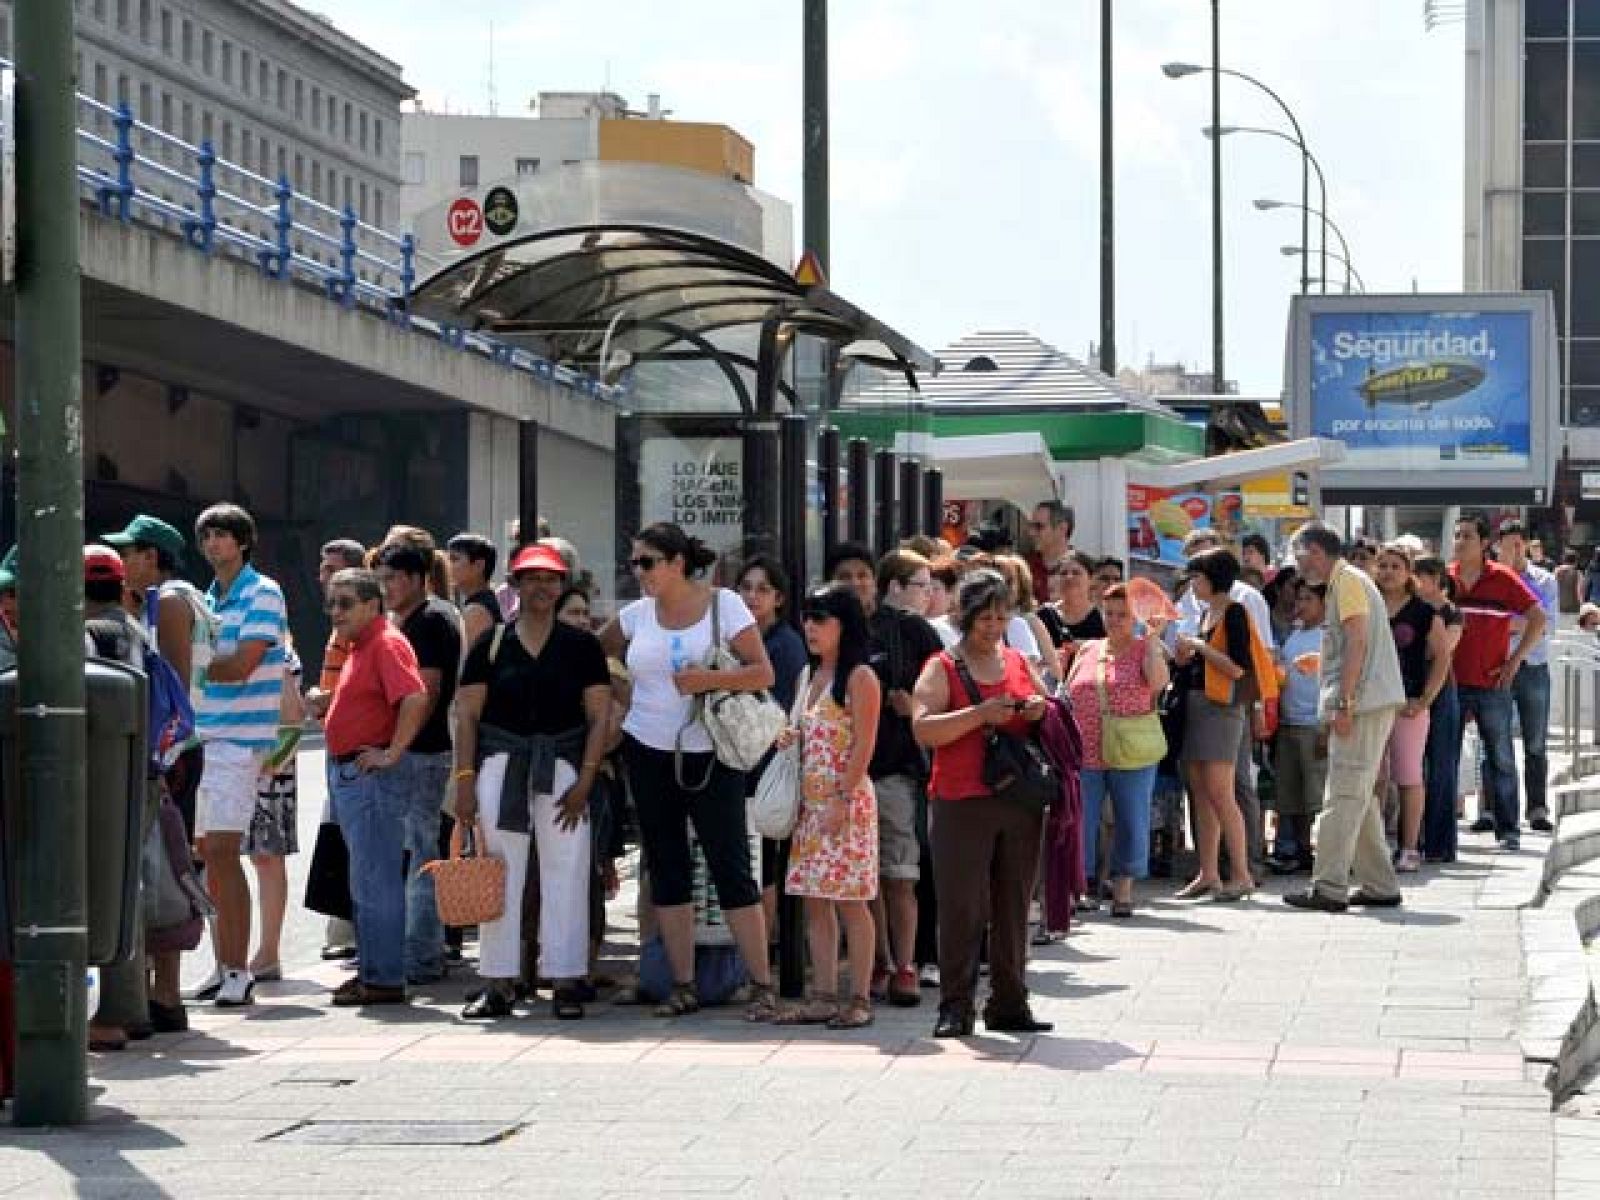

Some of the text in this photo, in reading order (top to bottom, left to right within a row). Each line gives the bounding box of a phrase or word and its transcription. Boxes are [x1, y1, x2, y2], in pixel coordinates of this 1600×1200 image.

[451, 208, 482, 236] C2
[1333, 329, 1496, 361] Seguridad,
[1332, 418, 1362, 434] por
[1365, 416, 1425, 431] encima
[672, 462, 696, 476] LO
[672, 495, 708, 508] LOS
[672, 510, 696, 525] LO
